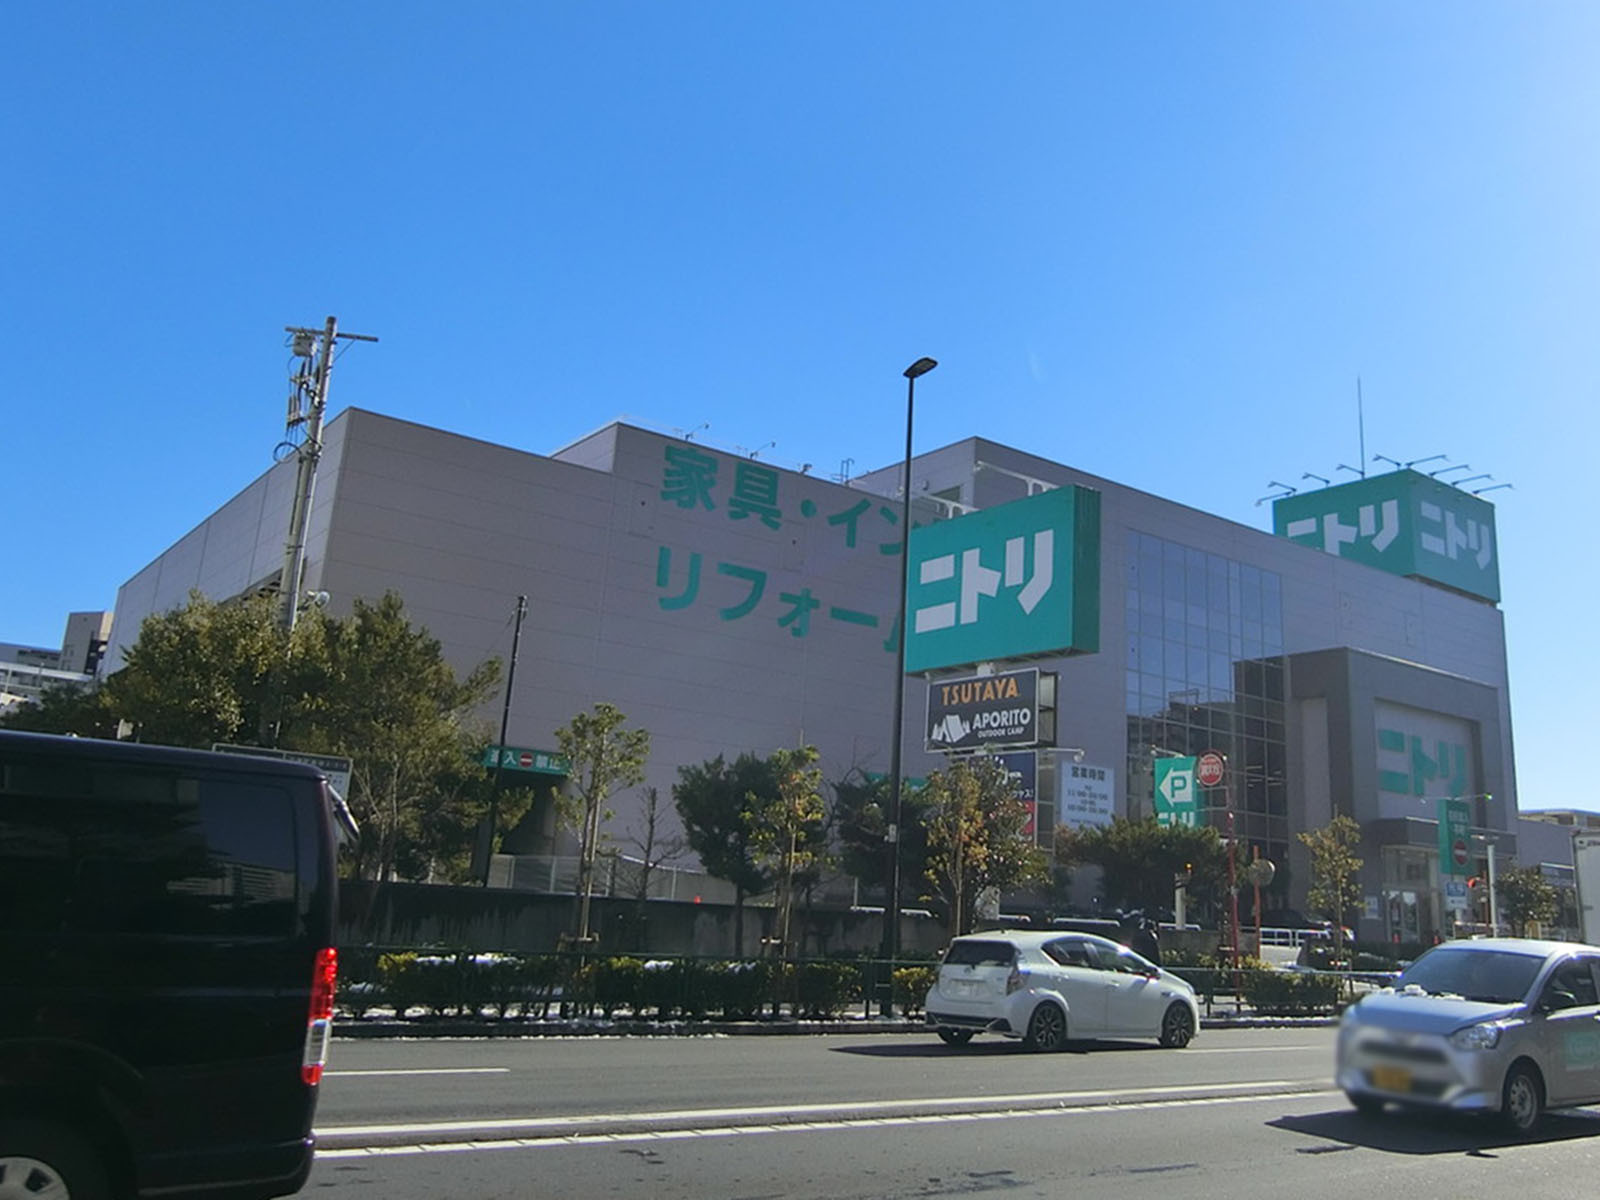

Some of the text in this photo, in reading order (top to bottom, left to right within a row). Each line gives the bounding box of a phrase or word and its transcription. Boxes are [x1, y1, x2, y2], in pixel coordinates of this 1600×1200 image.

[1420, 501, 1491, 571] ニトリ
[915, 529, 1055, 635] ニトリ
[942, 677, 1019, 706] TSUTAYA
[972, 708, 1031, 730] APORITO
[977, 726, 1025, 739] OUTDOOR CAMP
[1378, 728, 1468, 800] ニトリ
[1171, 775, 1187, 798] P
